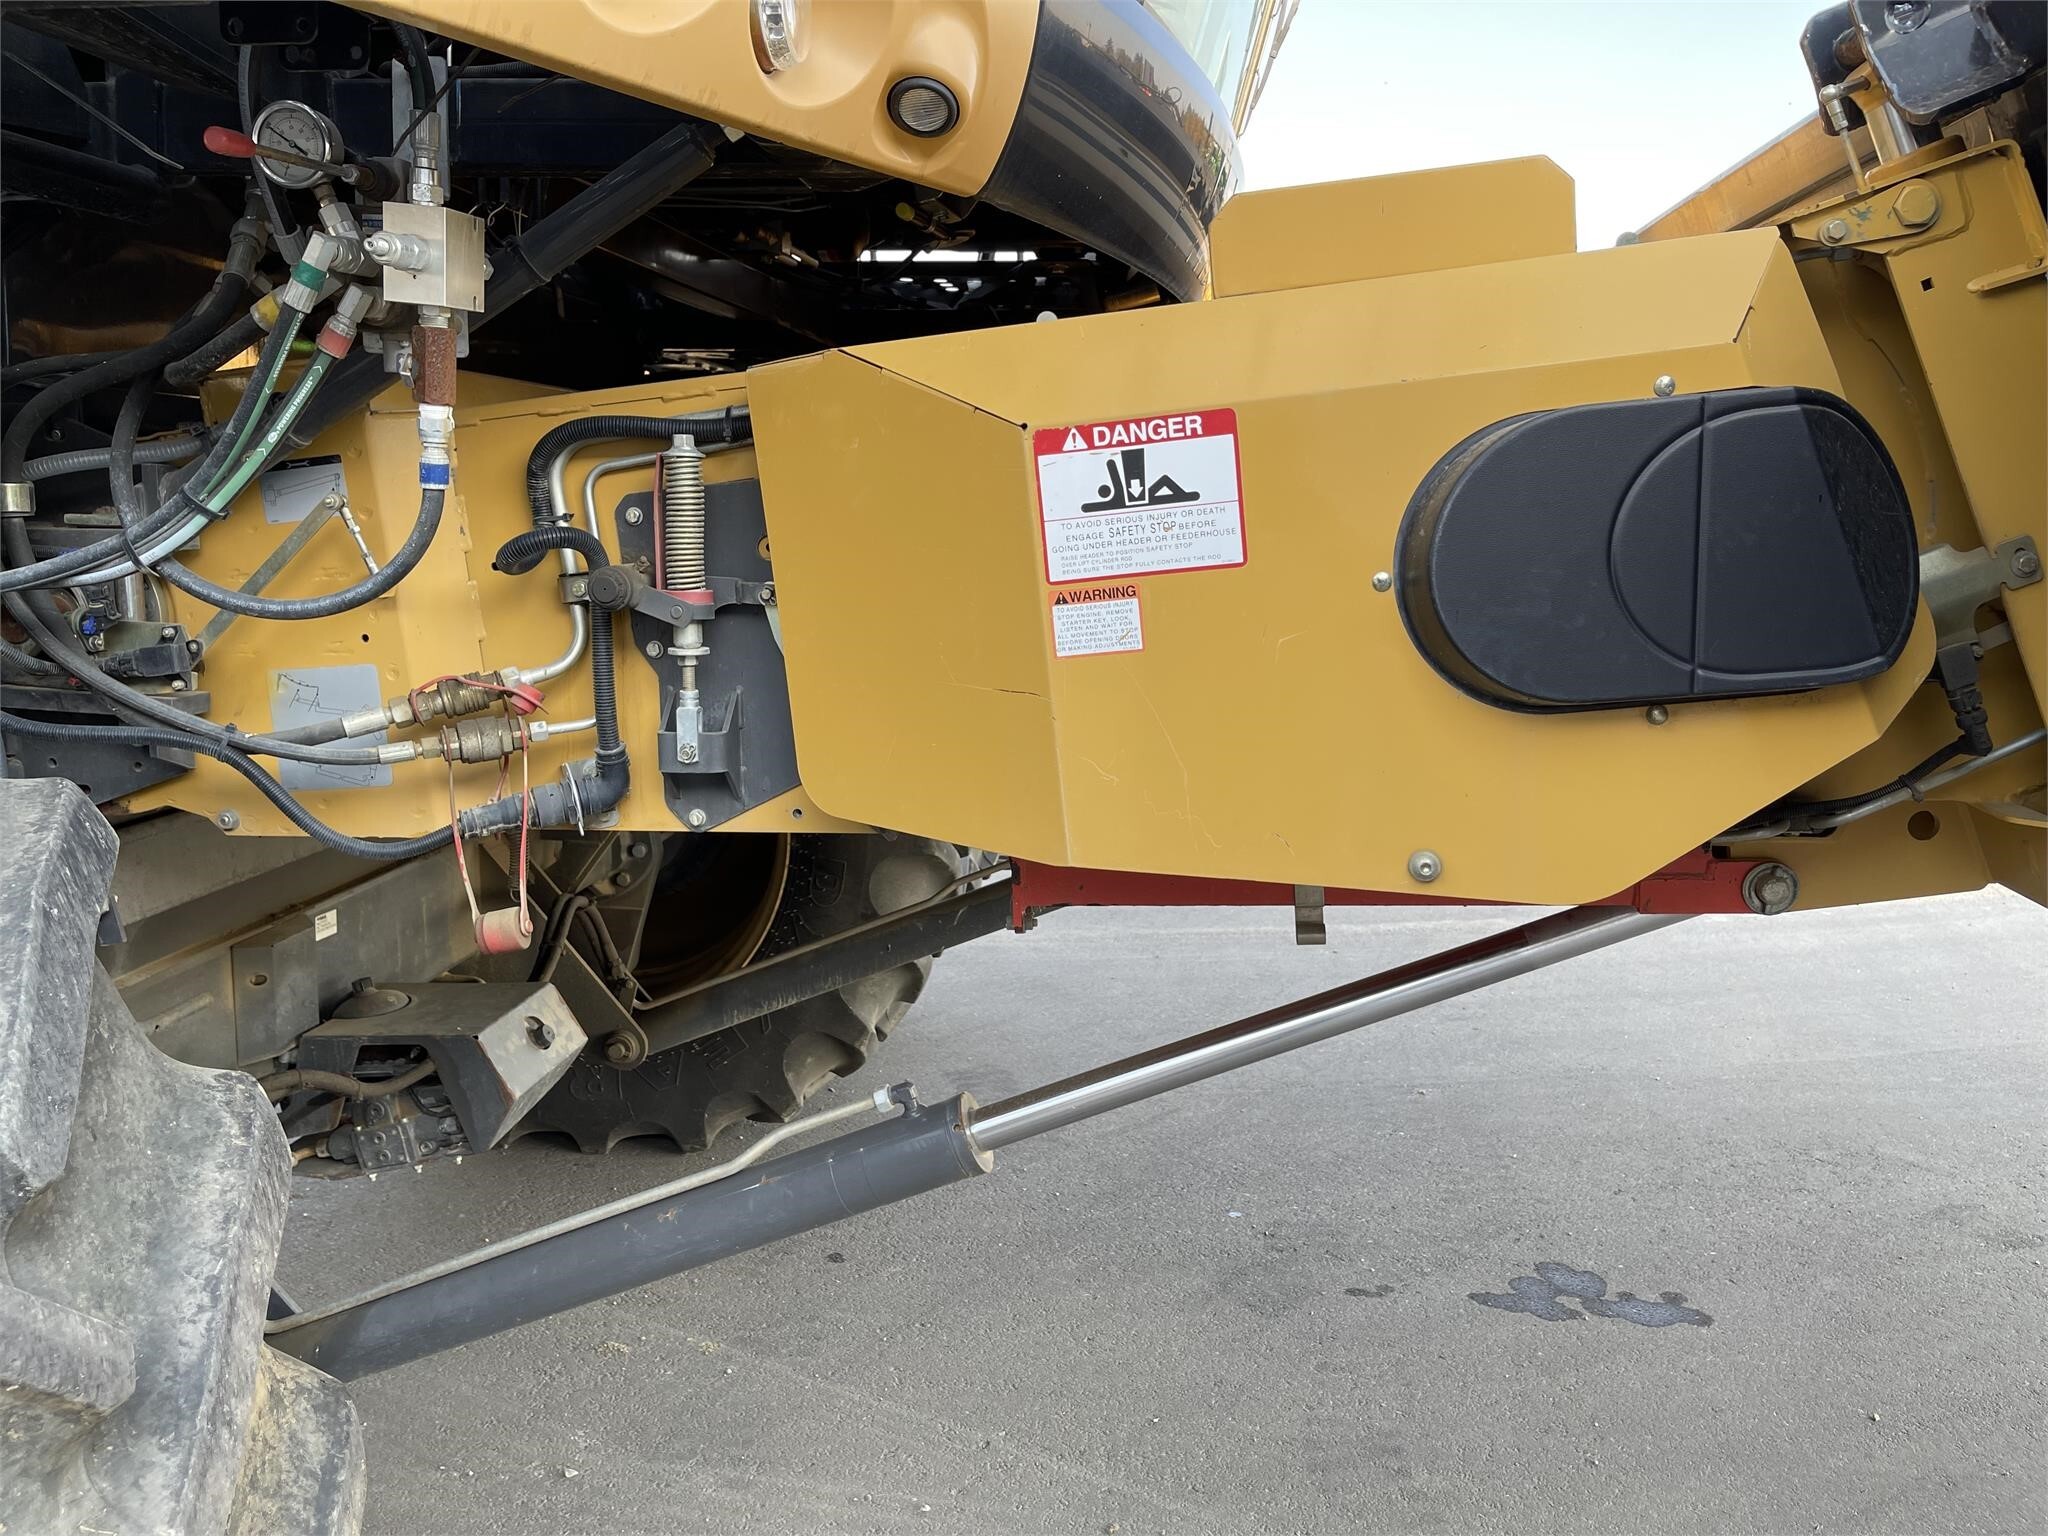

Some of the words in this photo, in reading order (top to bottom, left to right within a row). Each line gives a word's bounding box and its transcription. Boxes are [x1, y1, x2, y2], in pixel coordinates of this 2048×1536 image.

[1092, 415, 1204, 447] DANGER
[1061, 522, 1073, 530] TO
[1075, 519, 1102, 530] AVOID
[1104, 514, 1144, 526] SERIOUS
[1146, 511, 1178, 522] INJURY
[1180, 509, 1194, 518] OR
[1196, 506, 1226, 516] DEATH
[1066, 532, 1104, 543] ENGAGE
[1108, 524, 1146, 538] SAFETY
[1150, 520, 1177, 534] STOP
[1178, 519, 1217, 530] BEFORE
[1052, 544, 1080, 554] GOING
[1082, 540, 1113, 551] UNDER
[1116, 536, 1152, 548] HEADER
[1154, 534, 1168, 542] OR
[1170, 528, 1237, 541] FEEDERHOUSE
[1116, 548, 1144, 556] POSITION
[1146, 544, 1172, 552] SAFETY
[1175, 542, 1193, 550] STOP
[1062, 568, 1081, 576] BEING
[1156, 556, 1192, 566] CONTACTS
[1091, 557, 1120, 566] CYLINDER
[1068, 585, 1136, 603] WARNING
[1086, 603, 1112, 611] SERIOUS
[1113, 600, 1134, 608] INJURY
[1071, 630, 1107, 638] MOVEMENT
[1085, 635, 1113, 643] OPENING
